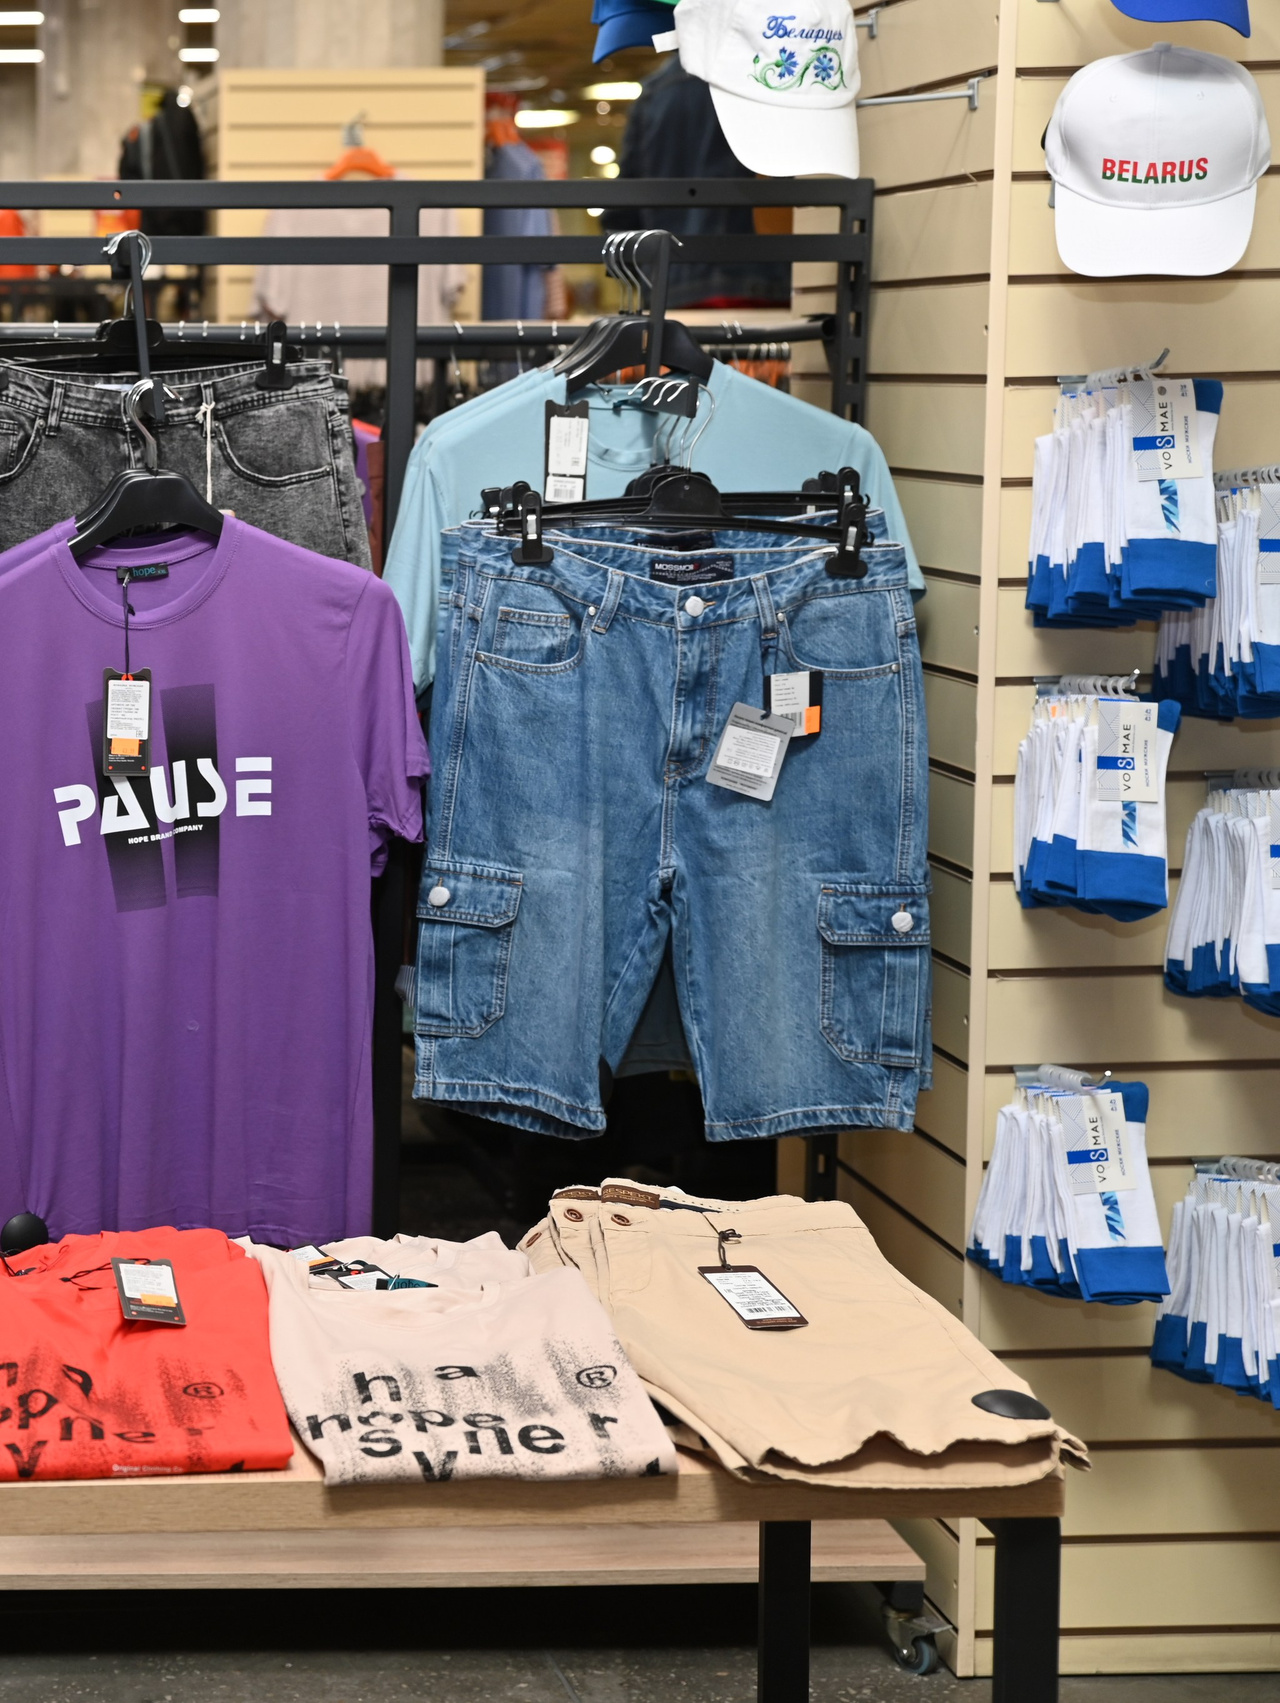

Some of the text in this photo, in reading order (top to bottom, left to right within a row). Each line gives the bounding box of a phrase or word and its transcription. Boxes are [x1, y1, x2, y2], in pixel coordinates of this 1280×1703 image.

[1102, 157, 1209, 185] BELARUS
[132, 566, 156, 577] hope
[53, 756, 272, 847] PAUSE
[128, 824, 204, 845] HOPE BRAND COMPANY
